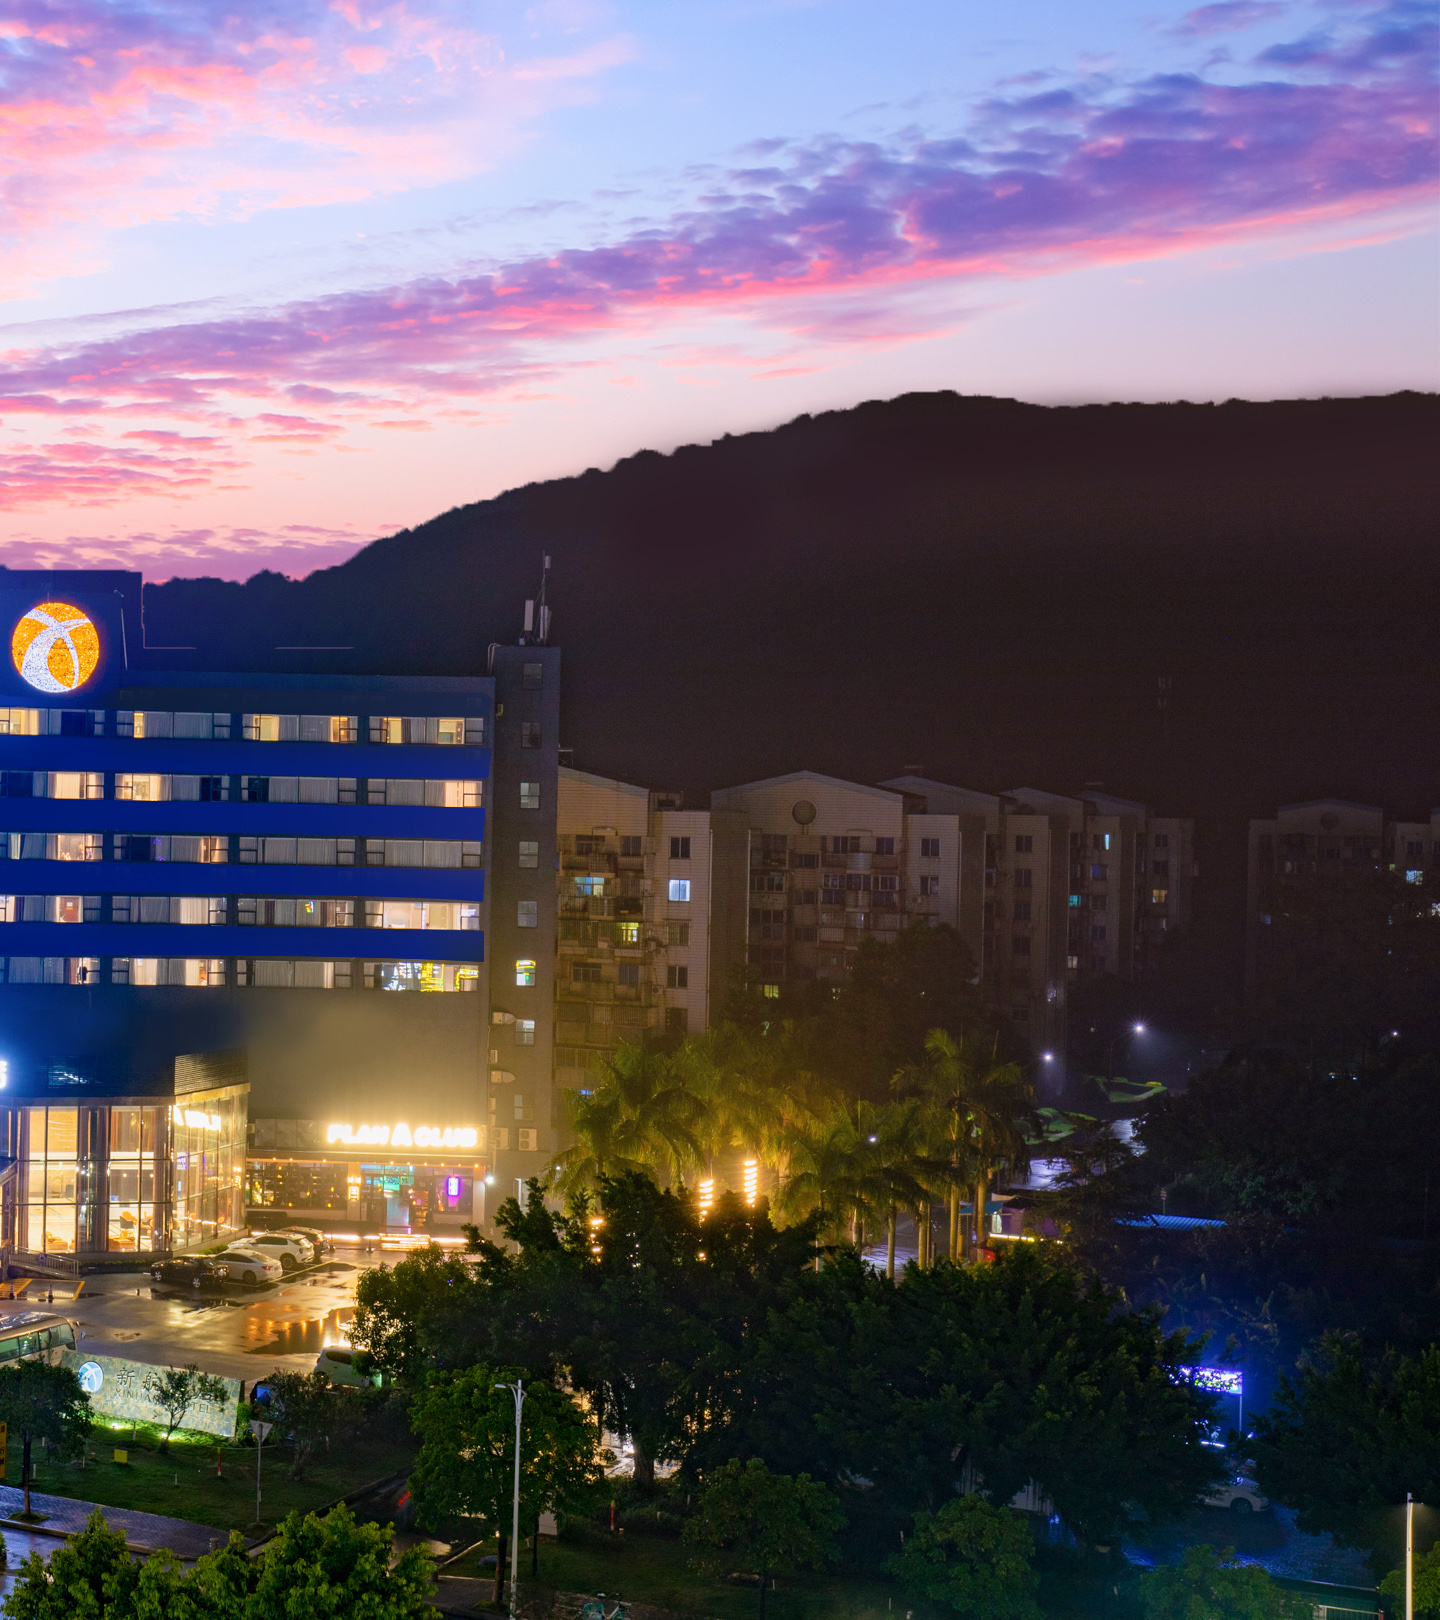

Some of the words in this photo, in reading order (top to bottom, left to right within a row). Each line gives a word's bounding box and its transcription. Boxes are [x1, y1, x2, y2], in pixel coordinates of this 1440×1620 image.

[327, 1123, 390, 1145] PLAN
[391, 1122, 413, 1146] A
[414, 1126, 477, 1147] CLUB
